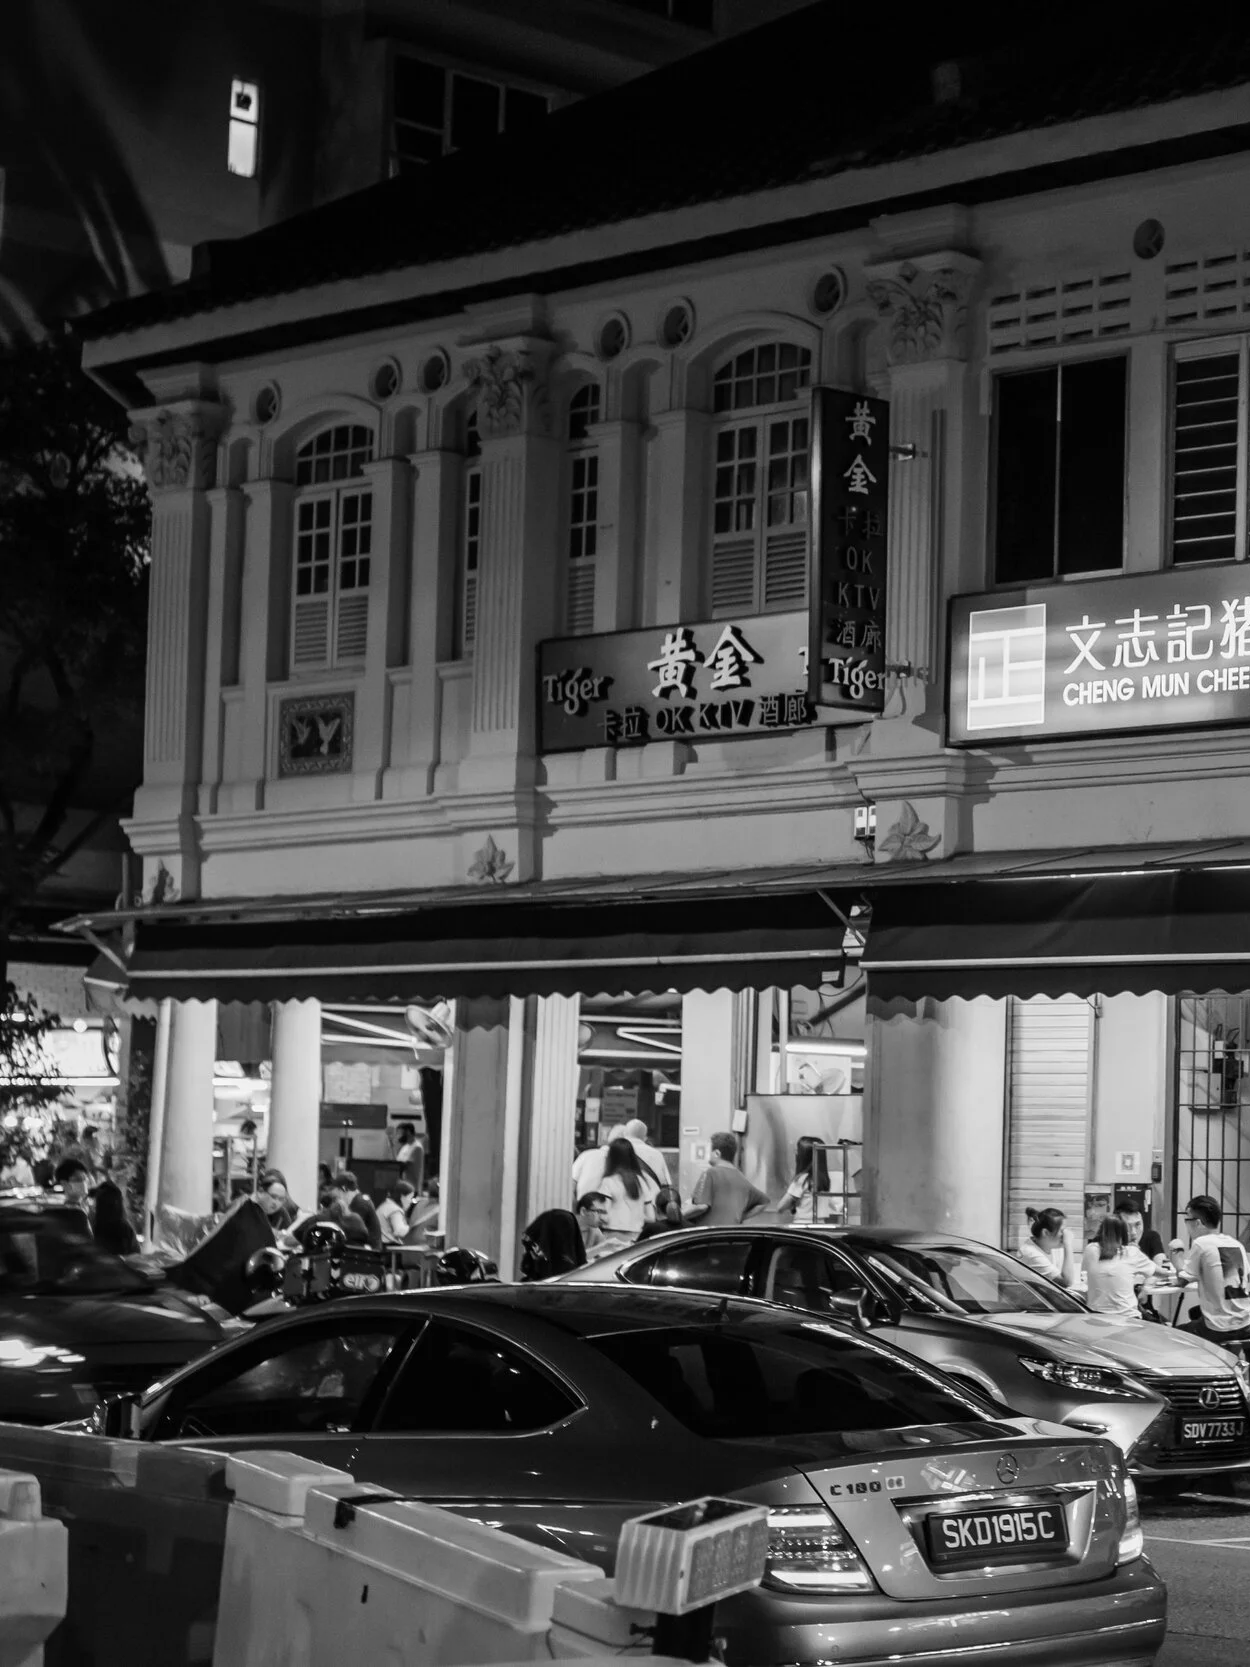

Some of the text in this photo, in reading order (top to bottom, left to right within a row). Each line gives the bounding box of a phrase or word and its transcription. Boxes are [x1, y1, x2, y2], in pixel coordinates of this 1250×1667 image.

[837, 507, 883, 540] 卡拉
[846, 546, 873, 573] OK
[838, 581, 880, 611] KTV
[836, 615, 882, 654] 酒廊
[543, 667, 604, 715] Tiger
[828, 656, 886, 699] Tiger
[1063, 678, 1135, 706] CHENG
[1142, 671, 1189, 698] MUN
[1196, 666, 1250, 693] CHEE
[597, 690, 807, 742] 卡拉 OK KTV 酒廊
[942, 1511, 1056, 1549] SKD1915C
